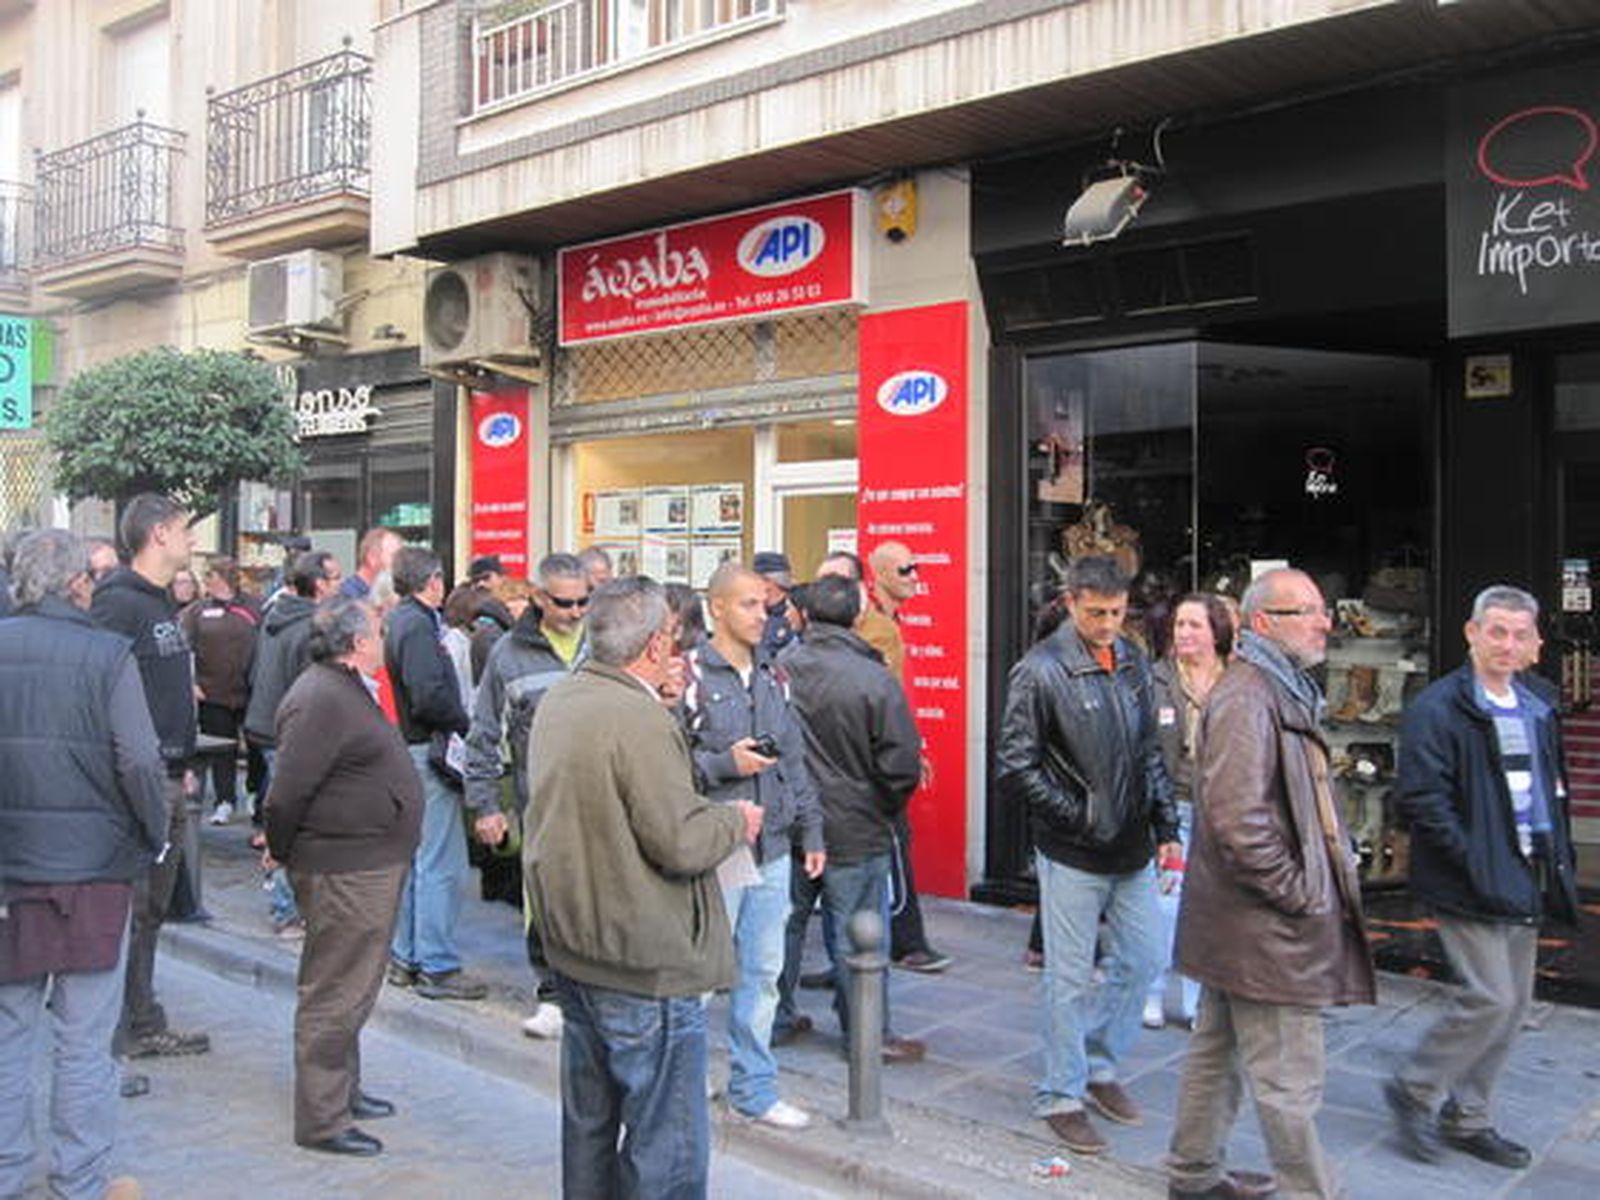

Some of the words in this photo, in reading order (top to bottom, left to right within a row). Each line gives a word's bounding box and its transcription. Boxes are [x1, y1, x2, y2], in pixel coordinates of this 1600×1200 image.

[1493, 190, 1571, 236] Ket
[755, 222, 810, 266] API
[892, 376, 937, 407] API
